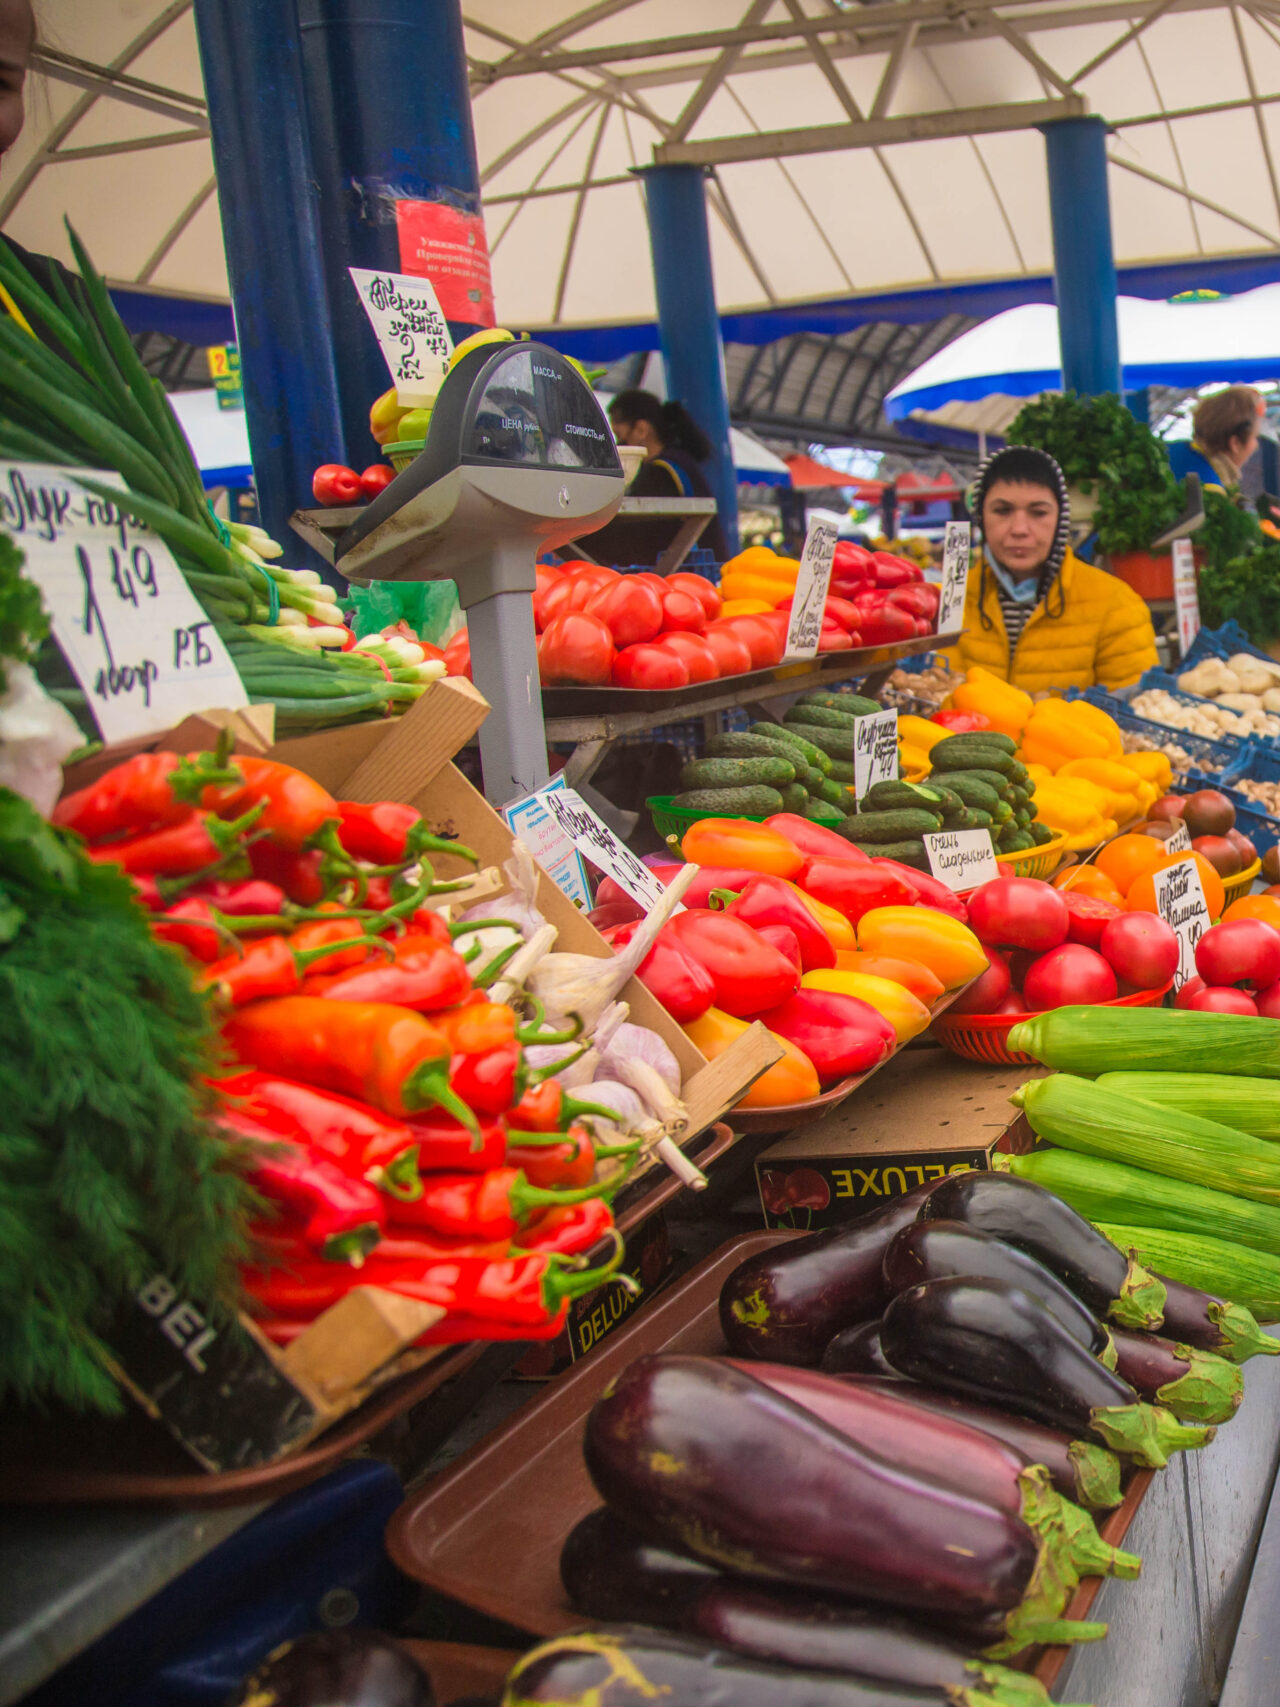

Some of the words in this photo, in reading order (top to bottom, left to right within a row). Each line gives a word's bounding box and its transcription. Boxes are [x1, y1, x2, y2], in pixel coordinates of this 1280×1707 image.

[215, 353, 226, 375] 2
[502, 419, 522, 431] ЦЕНА
[110, 545, 158, 608] 49
[138, 1275, 217, 1372] BEL
